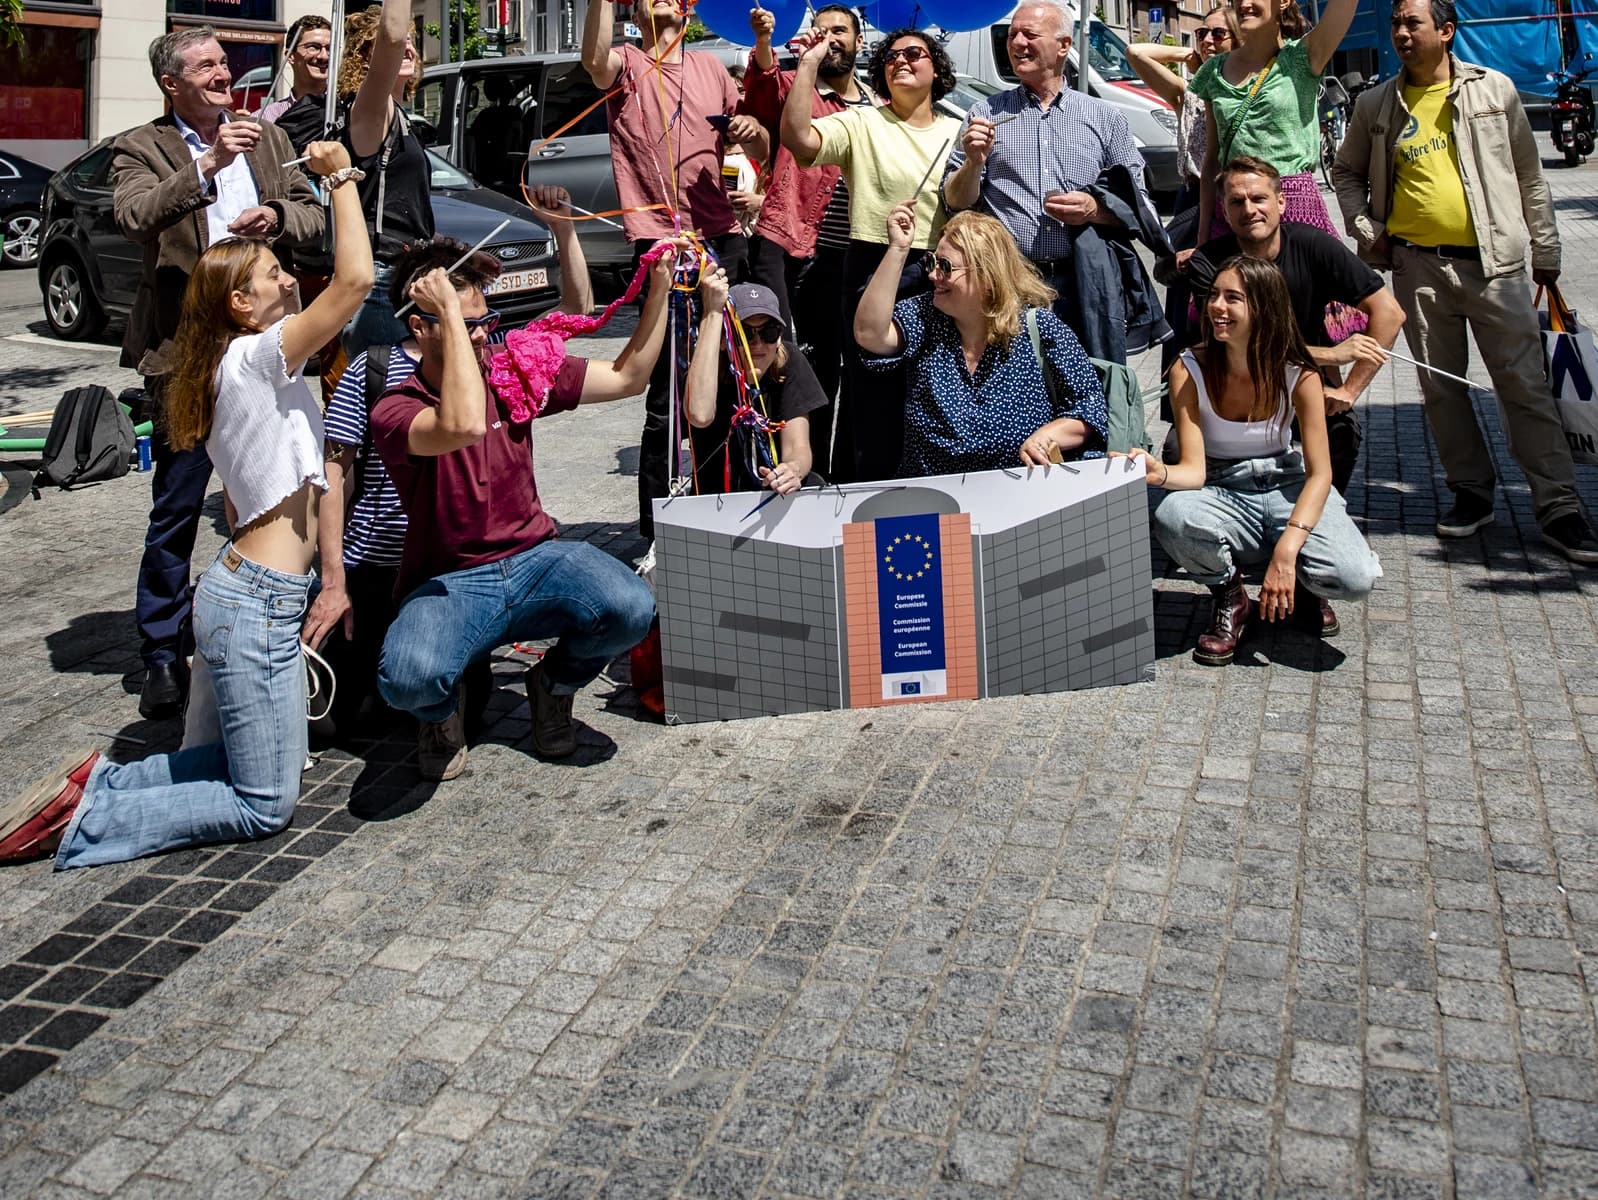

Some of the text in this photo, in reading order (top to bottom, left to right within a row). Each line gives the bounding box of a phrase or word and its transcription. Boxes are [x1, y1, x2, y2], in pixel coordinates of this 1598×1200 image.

[896, 593, 925, 601] Europese
[894, 601, 928, 609] Commissie
[893, 617, 931, 625] Commission
[893, 625, 931, 634] européenne
[898, 641, 928, 649] European
[894, 649, 932, 657] Commission
